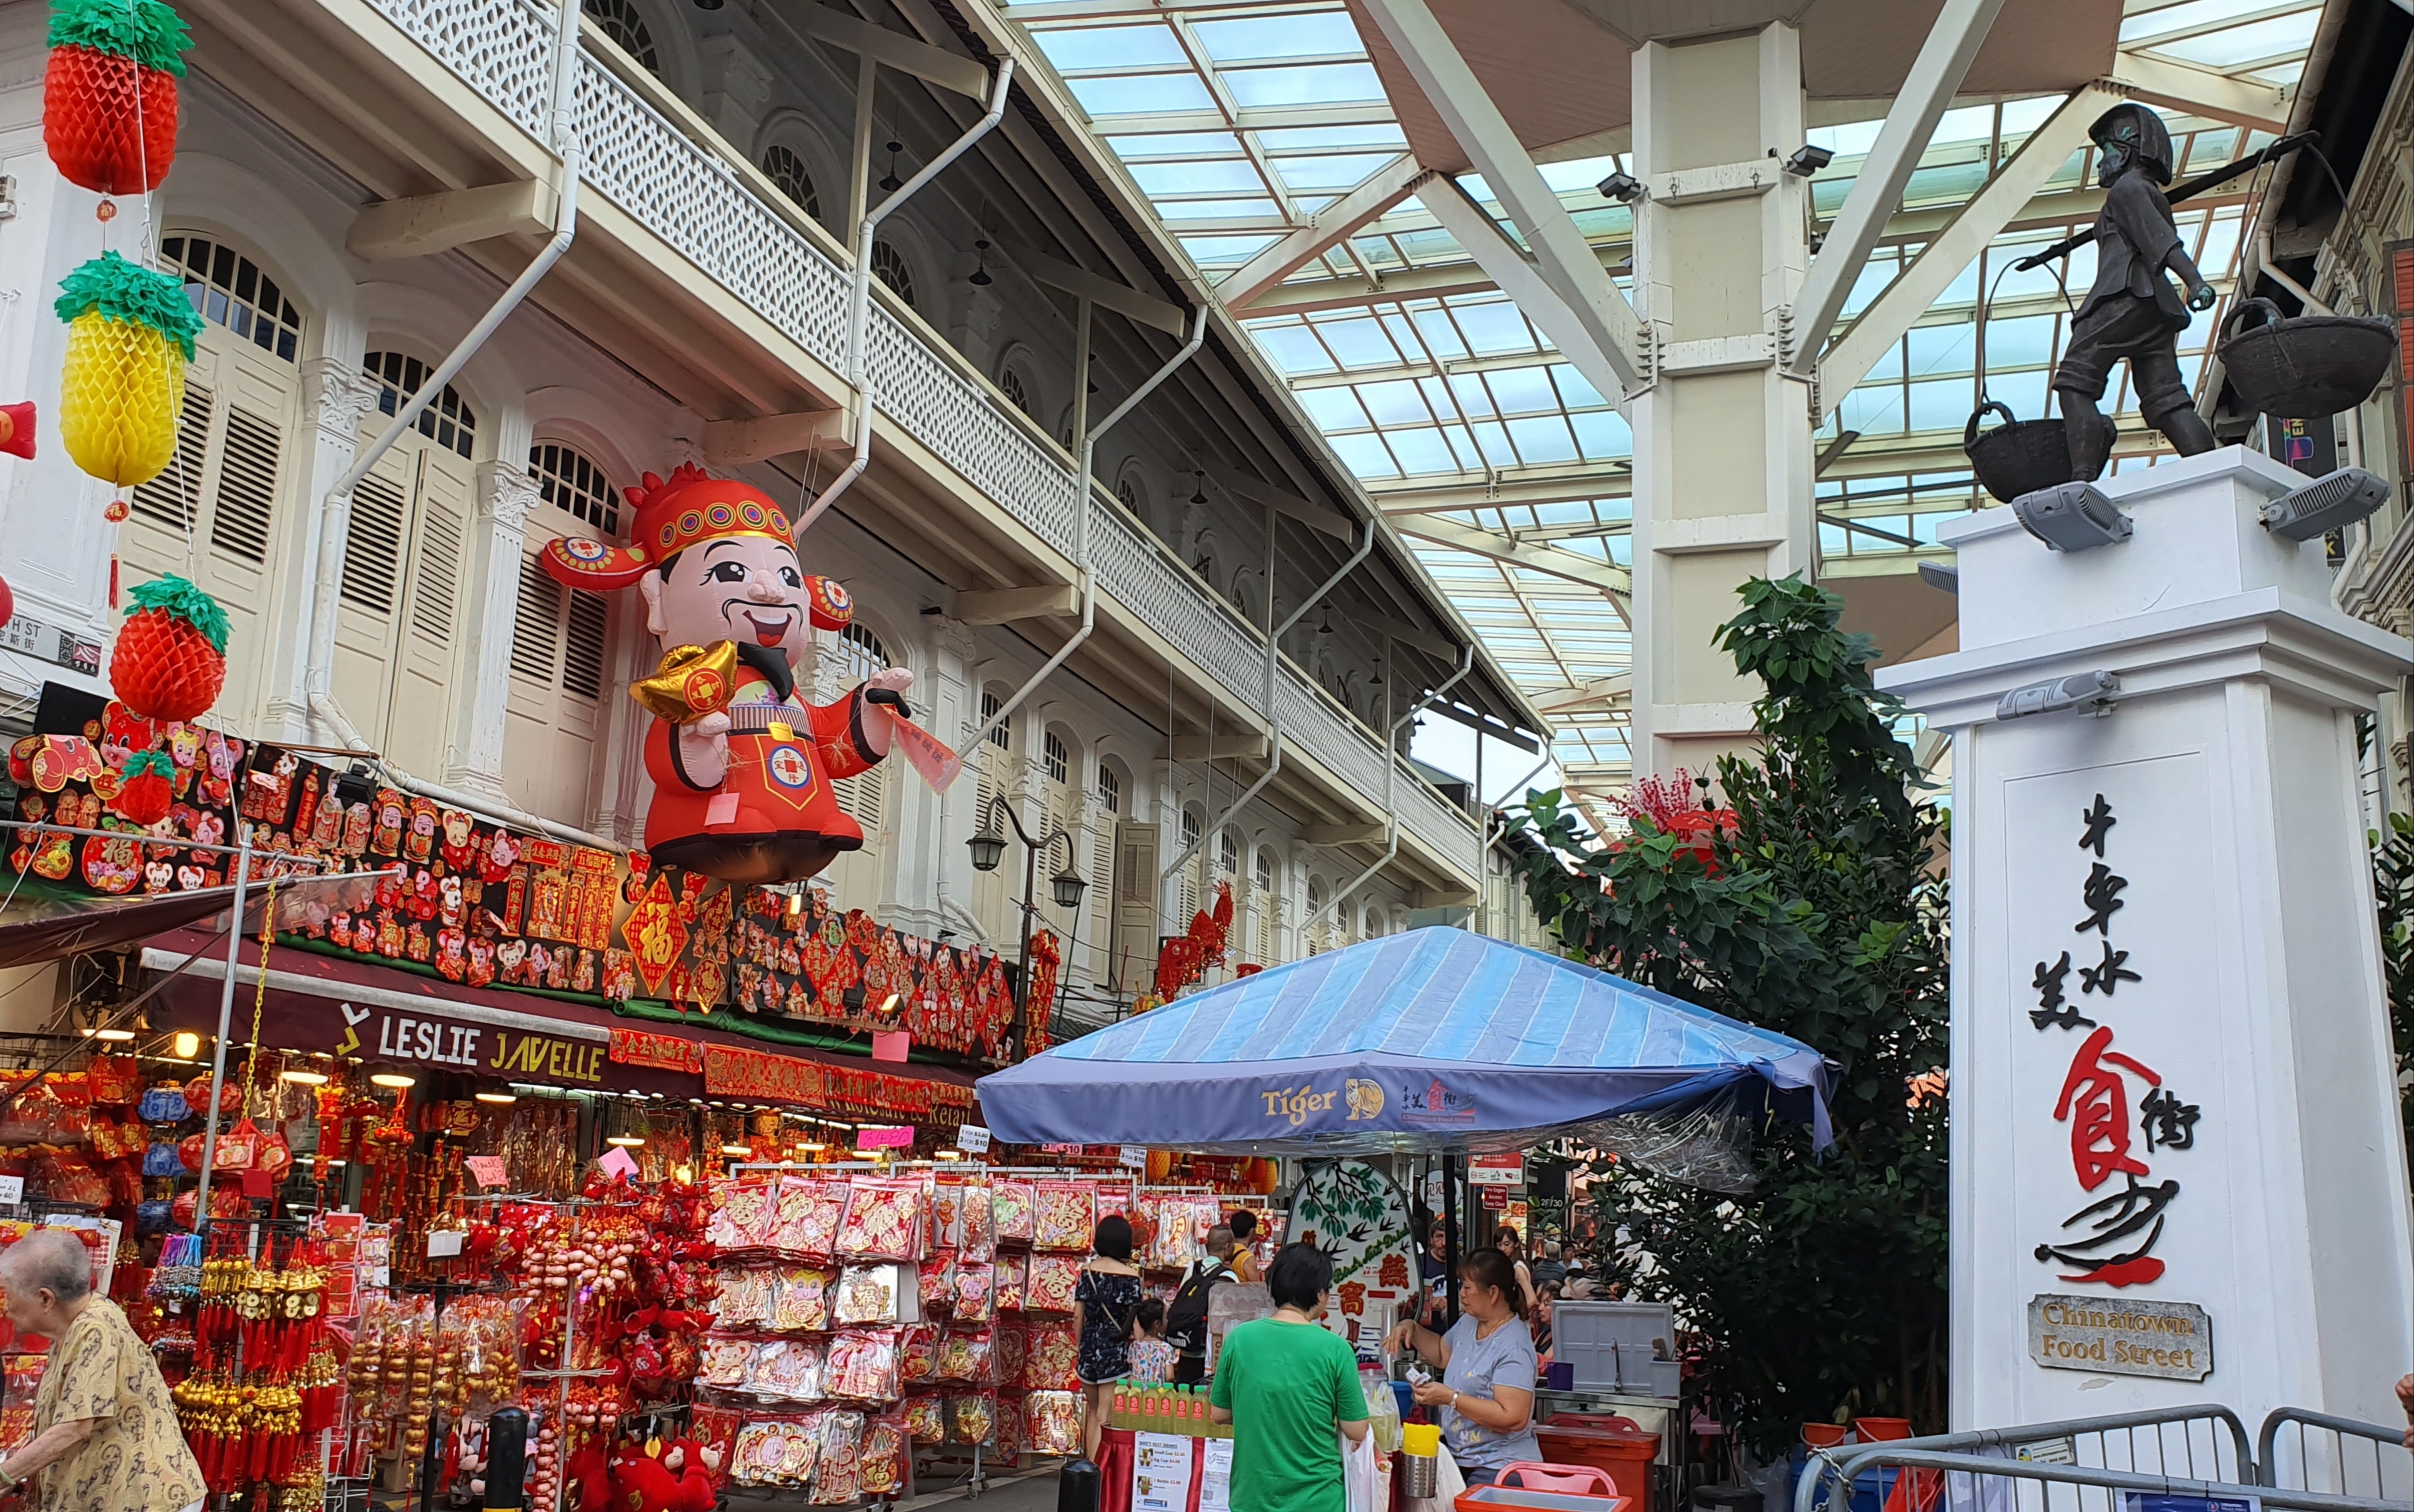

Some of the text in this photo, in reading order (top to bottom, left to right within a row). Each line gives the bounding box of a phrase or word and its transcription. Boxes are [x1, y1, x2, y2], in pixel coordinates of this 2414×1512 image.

[25, 623, 41, 638] ST
[379, 1015, 605, 1082] LESLIE JAVELLE
[929, 1102, 971, 1127] Retail
[1261, 1085, 1338, 1127] Tiger
[975, 1139, 987, 1147] $10
[1063, 1144, 1080, 1155] $10
[1134, 1155, 1145, 1163] $10
[2042, 1302, 2192, 1336] Chinatown
[2042, 1334, 2195, 1369] Food Street
